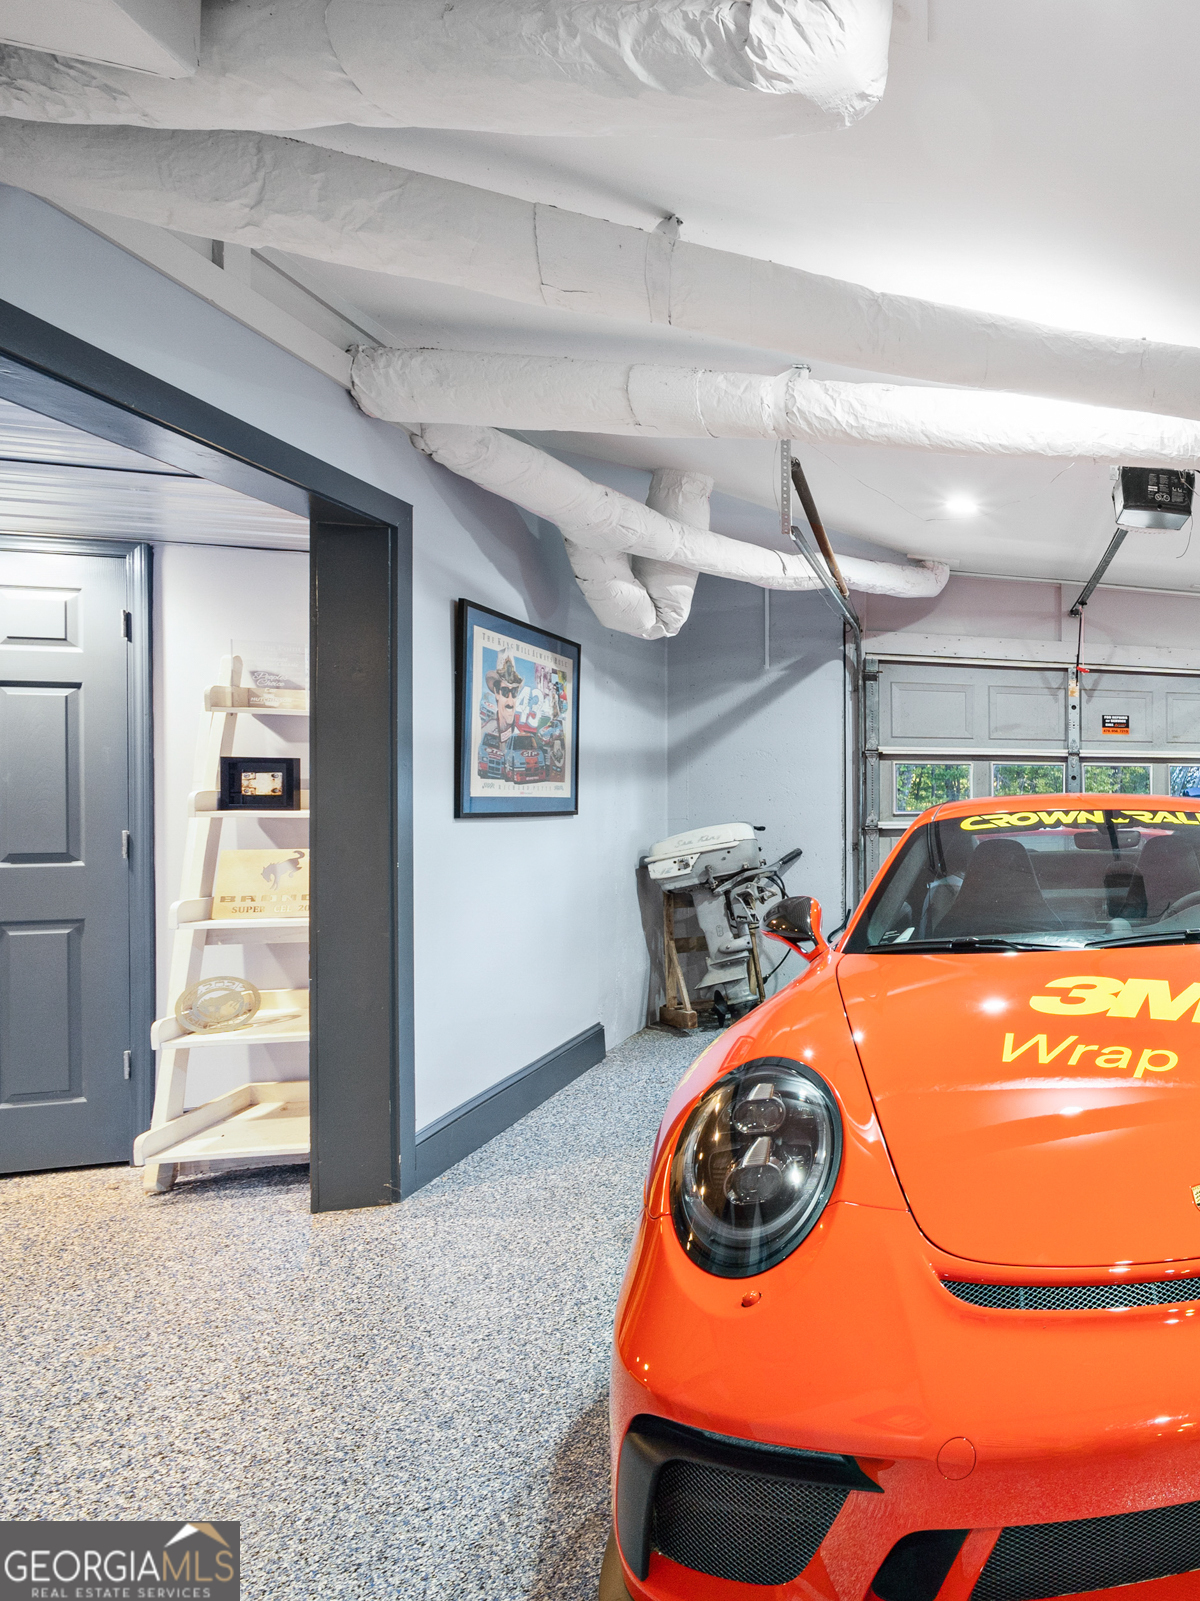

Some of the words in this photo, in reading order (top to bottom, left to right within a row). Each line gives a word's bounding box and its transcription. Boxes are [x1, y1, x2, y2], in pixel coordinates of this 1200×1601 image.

[516, 685, 544, 728] 43
[522, 750, 539, 758] STP
[960, 810, 1105, 831] CROWN
[231, 904, 266, 914] SUPER
[273, 904, 292, 913] CEL
[1001, 1032, 1179, 1079] Wrap
